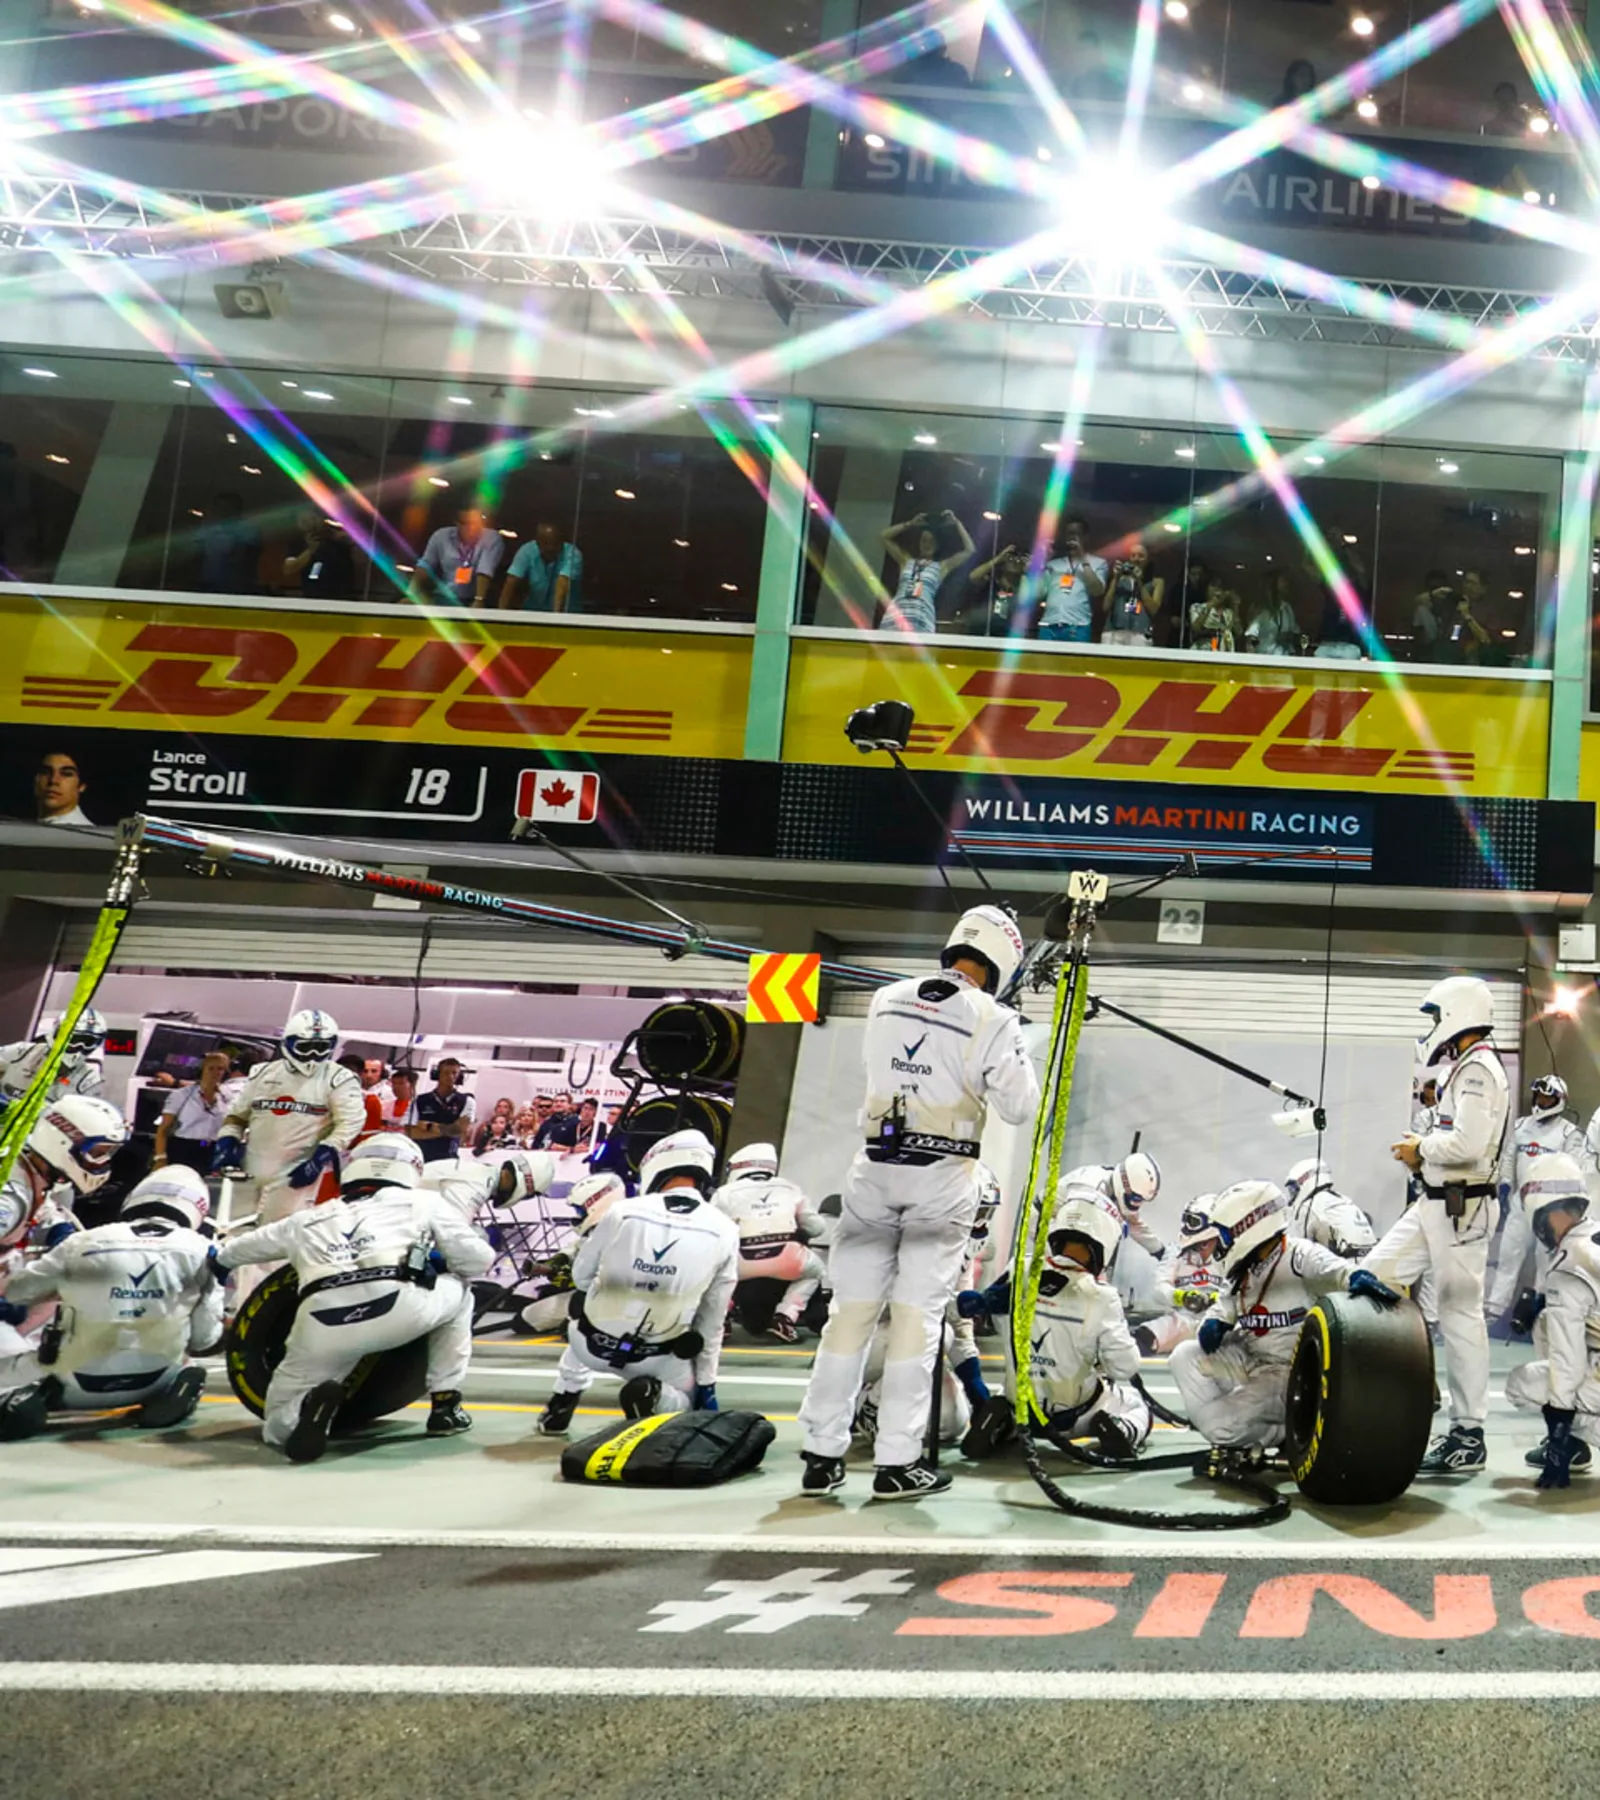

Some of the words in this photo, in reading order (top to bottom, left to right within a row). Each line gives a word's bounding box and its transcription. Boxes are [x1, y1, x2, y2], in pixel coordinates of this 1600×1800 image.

[108, 623, 590, 737] DHL
[943, 669, 1397, 778] DHL
[152, 749, 206, 765] Lance
[148, 767, 246, 796] Stroll
[404, 768, 450, 806] 18
[966, 799, 1109, 826] WILLIAMS
[1114, 806, 1247, 831] MARTINI
[1250, 811, 1361, 836] RACING
[442, 885, 503, 909] RACING
[1078, 877, 1100, 893] W
[1162, 907, 1200, 935] 23
[891, 1057, 932, 1075] Rexona
[261, 1100, 308, 1112] MARTINI
[632, 1258, 677, 1276] Rexona
[109, 1287, 165, 1299] Rexona
